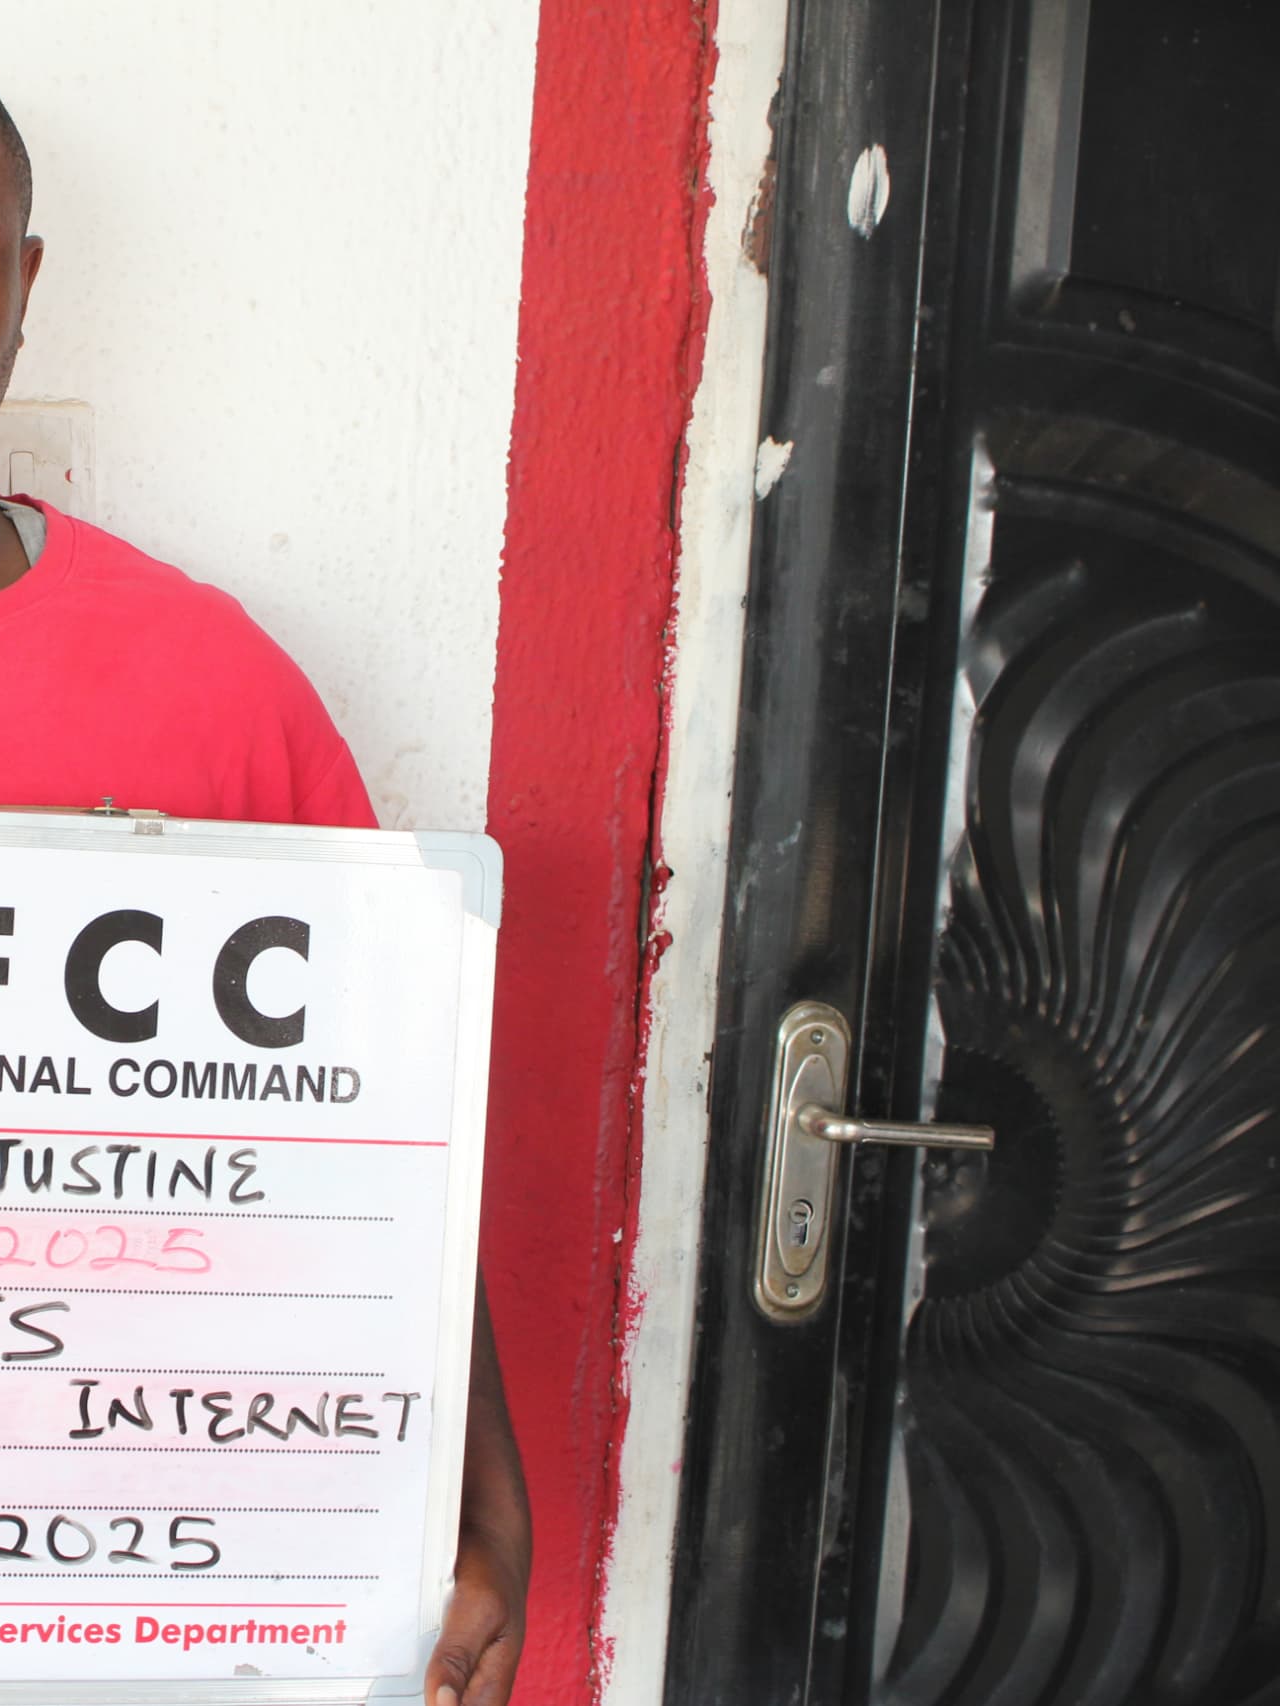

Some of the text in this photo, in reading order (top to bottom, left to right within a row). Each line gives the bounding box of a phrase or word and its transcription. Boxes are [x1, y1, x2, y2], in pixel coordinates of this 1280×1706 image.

[108, 1057, 361, 1104] COMMAND
[68, 1379, 421, 1443] INTERNET
[134, 1615, 347, 1652] Department
